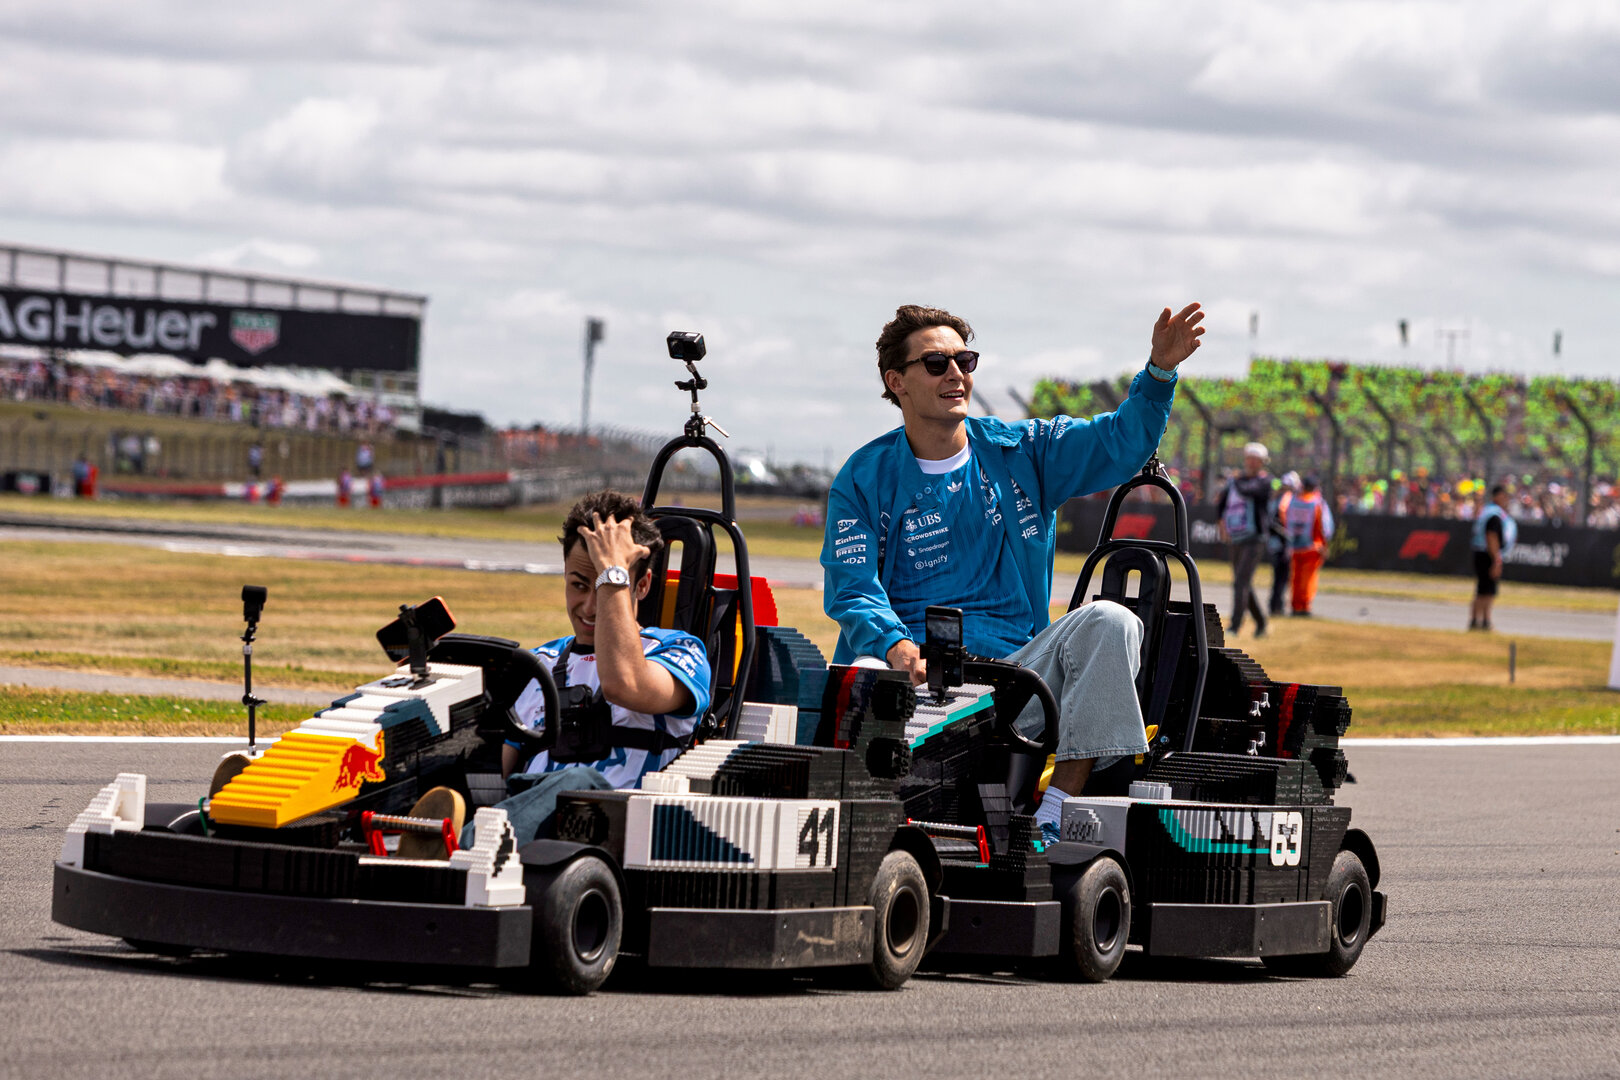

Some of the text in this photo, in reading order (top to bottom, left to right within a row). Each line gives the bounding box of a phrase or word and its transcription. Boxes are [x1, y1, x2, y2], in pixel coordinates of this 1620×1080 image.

[917, 512, 942, 528] UBS
[835, 533, 867, 546] Einhell
[906, 526, 949, 543] CROWDSTRIKE
[836, 544, 866, 558] PIRELLI
[918, 540, 950, 553] Snapdragon
[798, 808, 835, 866] 41
[1270, 812, 1303, 866] 63
